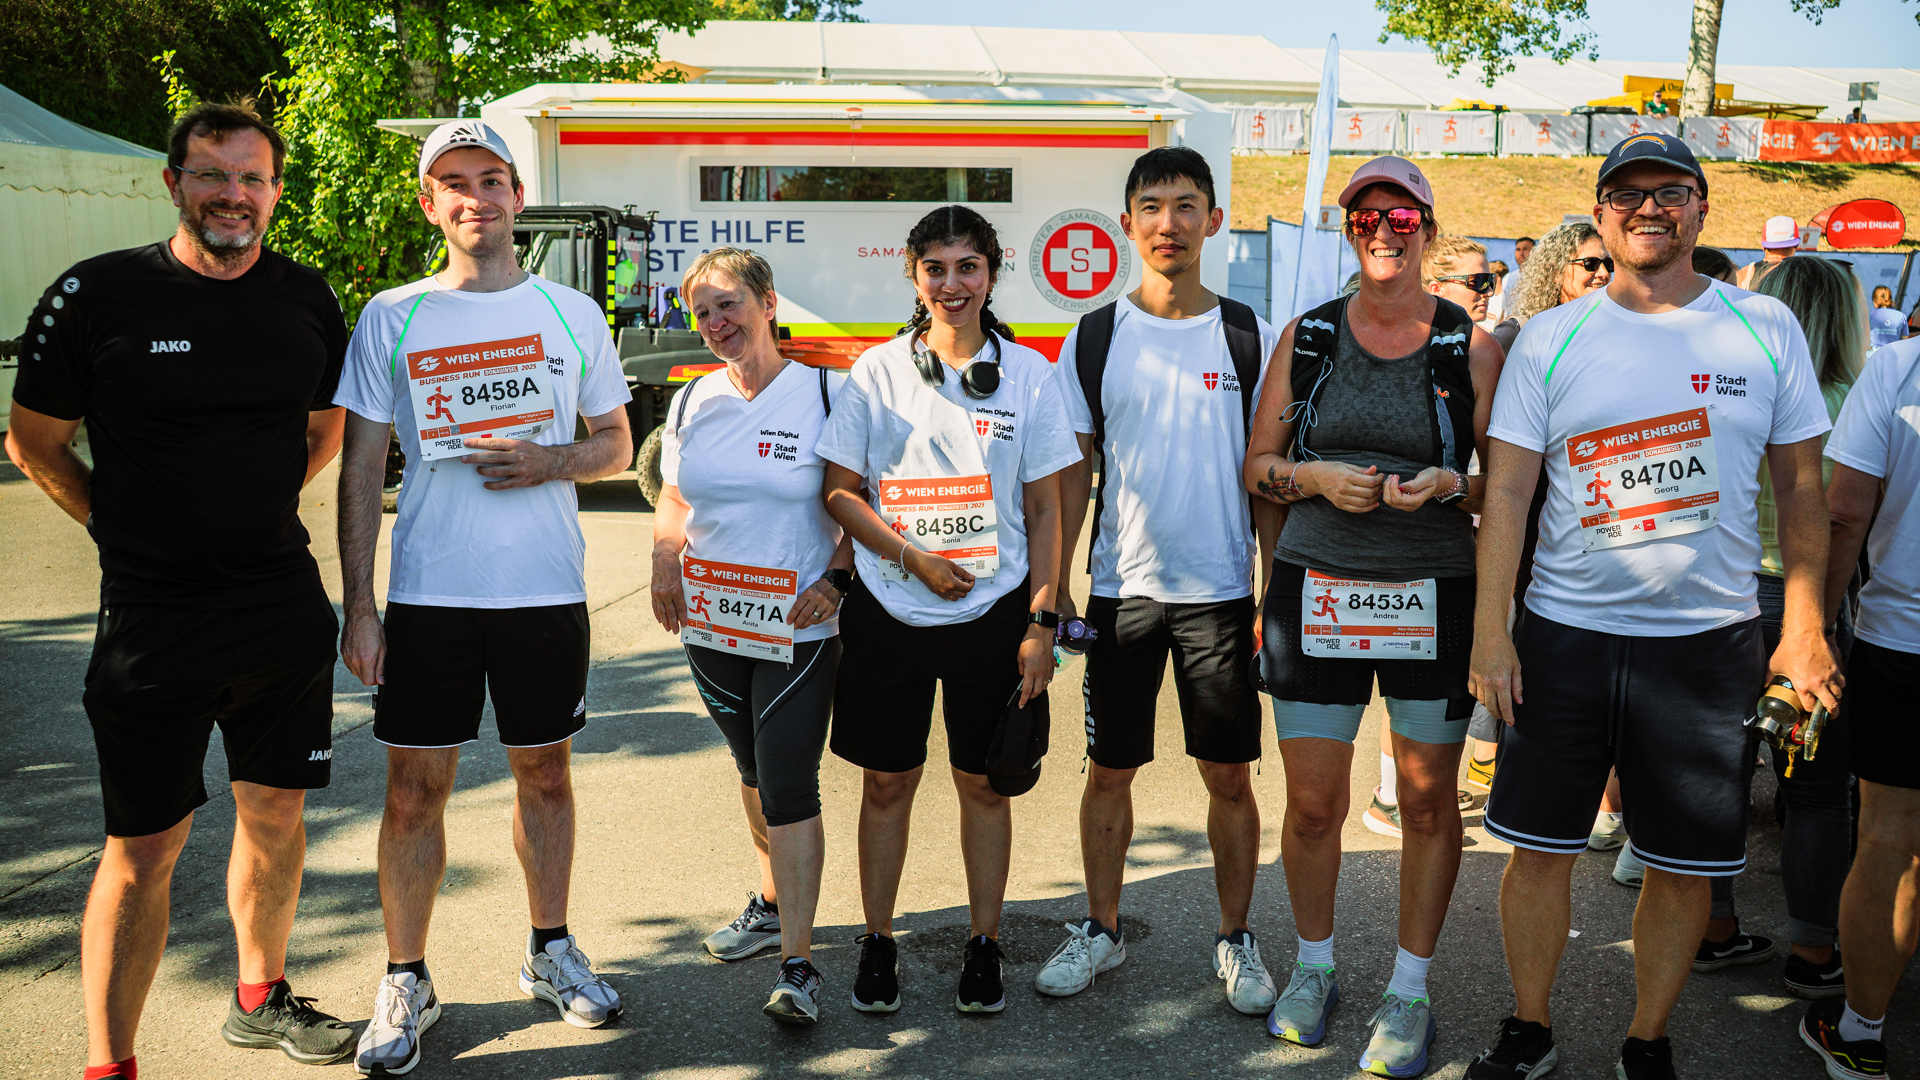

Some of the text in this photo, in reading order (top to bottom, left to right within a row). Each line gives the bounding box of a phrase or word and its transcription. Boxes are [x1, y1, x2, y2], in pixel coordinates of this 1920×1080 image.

[1762, 132, 1796, 149] RGIE
[1850, 135, 1906, 151] WIEN
[712, 220, 805, 243] HILFE
[1847, 221, 1900, 230] WIEN ENERGIE
[1032, 213, 1128, 278] ARBEITER SAMARITER BUND
[648, 249, 685, 272] ST
[1071, 248, 1089, 272] S
[150, 340, 192, 354] JAKO
[444, 344, 537, 366] WIEN ENERGIE
[546, 355, 564, 366] tadt
[419, 374, 460, 386] BUSINESS
[462, 371, 481, 380] RUN
[484, 366, 518, 376] DONAUINSEL
[1222, 372, 1239, 382] Sta
[1716, 374, 1747, 386] Stadt
[461, 376, 540, 406] 8458A
[1222, 382, 1242, 392] Wie
[1716, 385, 1746, 398] Wien
[490, 402, 516, 412] Florian
[994, 409, 1016, 418] Digital
[992, 422, 1015, 433] Stadt
[1602, 419, 1701, 448] WIEN ENERGIE
[777, 430, 800, 439] Digital
[992, 430, 1014, 442] Wien
[435, 438, 460, 447] POWER
[774, 443, 798, 454] Stadt
[774, 451, 796, 462] Wien
[1578, 440, 1702, 473] BUSINESS RUN DONAUINSEL 2025
[1620, 456, 1706, 490] 8470A
[906, 484, 986, 497] WIEN ENERGIE
[1654, 485, 1680, 494] Georg
[916, 514, 984, 536] 8458C
[1596, 525, 1622, 535] POWER
[1608, 530, 1622, 538] ADE
[711, 569, 790, 587] WIEN ENERGIE
[688, 580, 720, 592] BUSINESS
[1348, 594, 1424, 610] 8453A
[719, 598, 784, 624] 8471A
[742, 620, 758, 628] Anita
[692, 630, 712, 638] POWER
